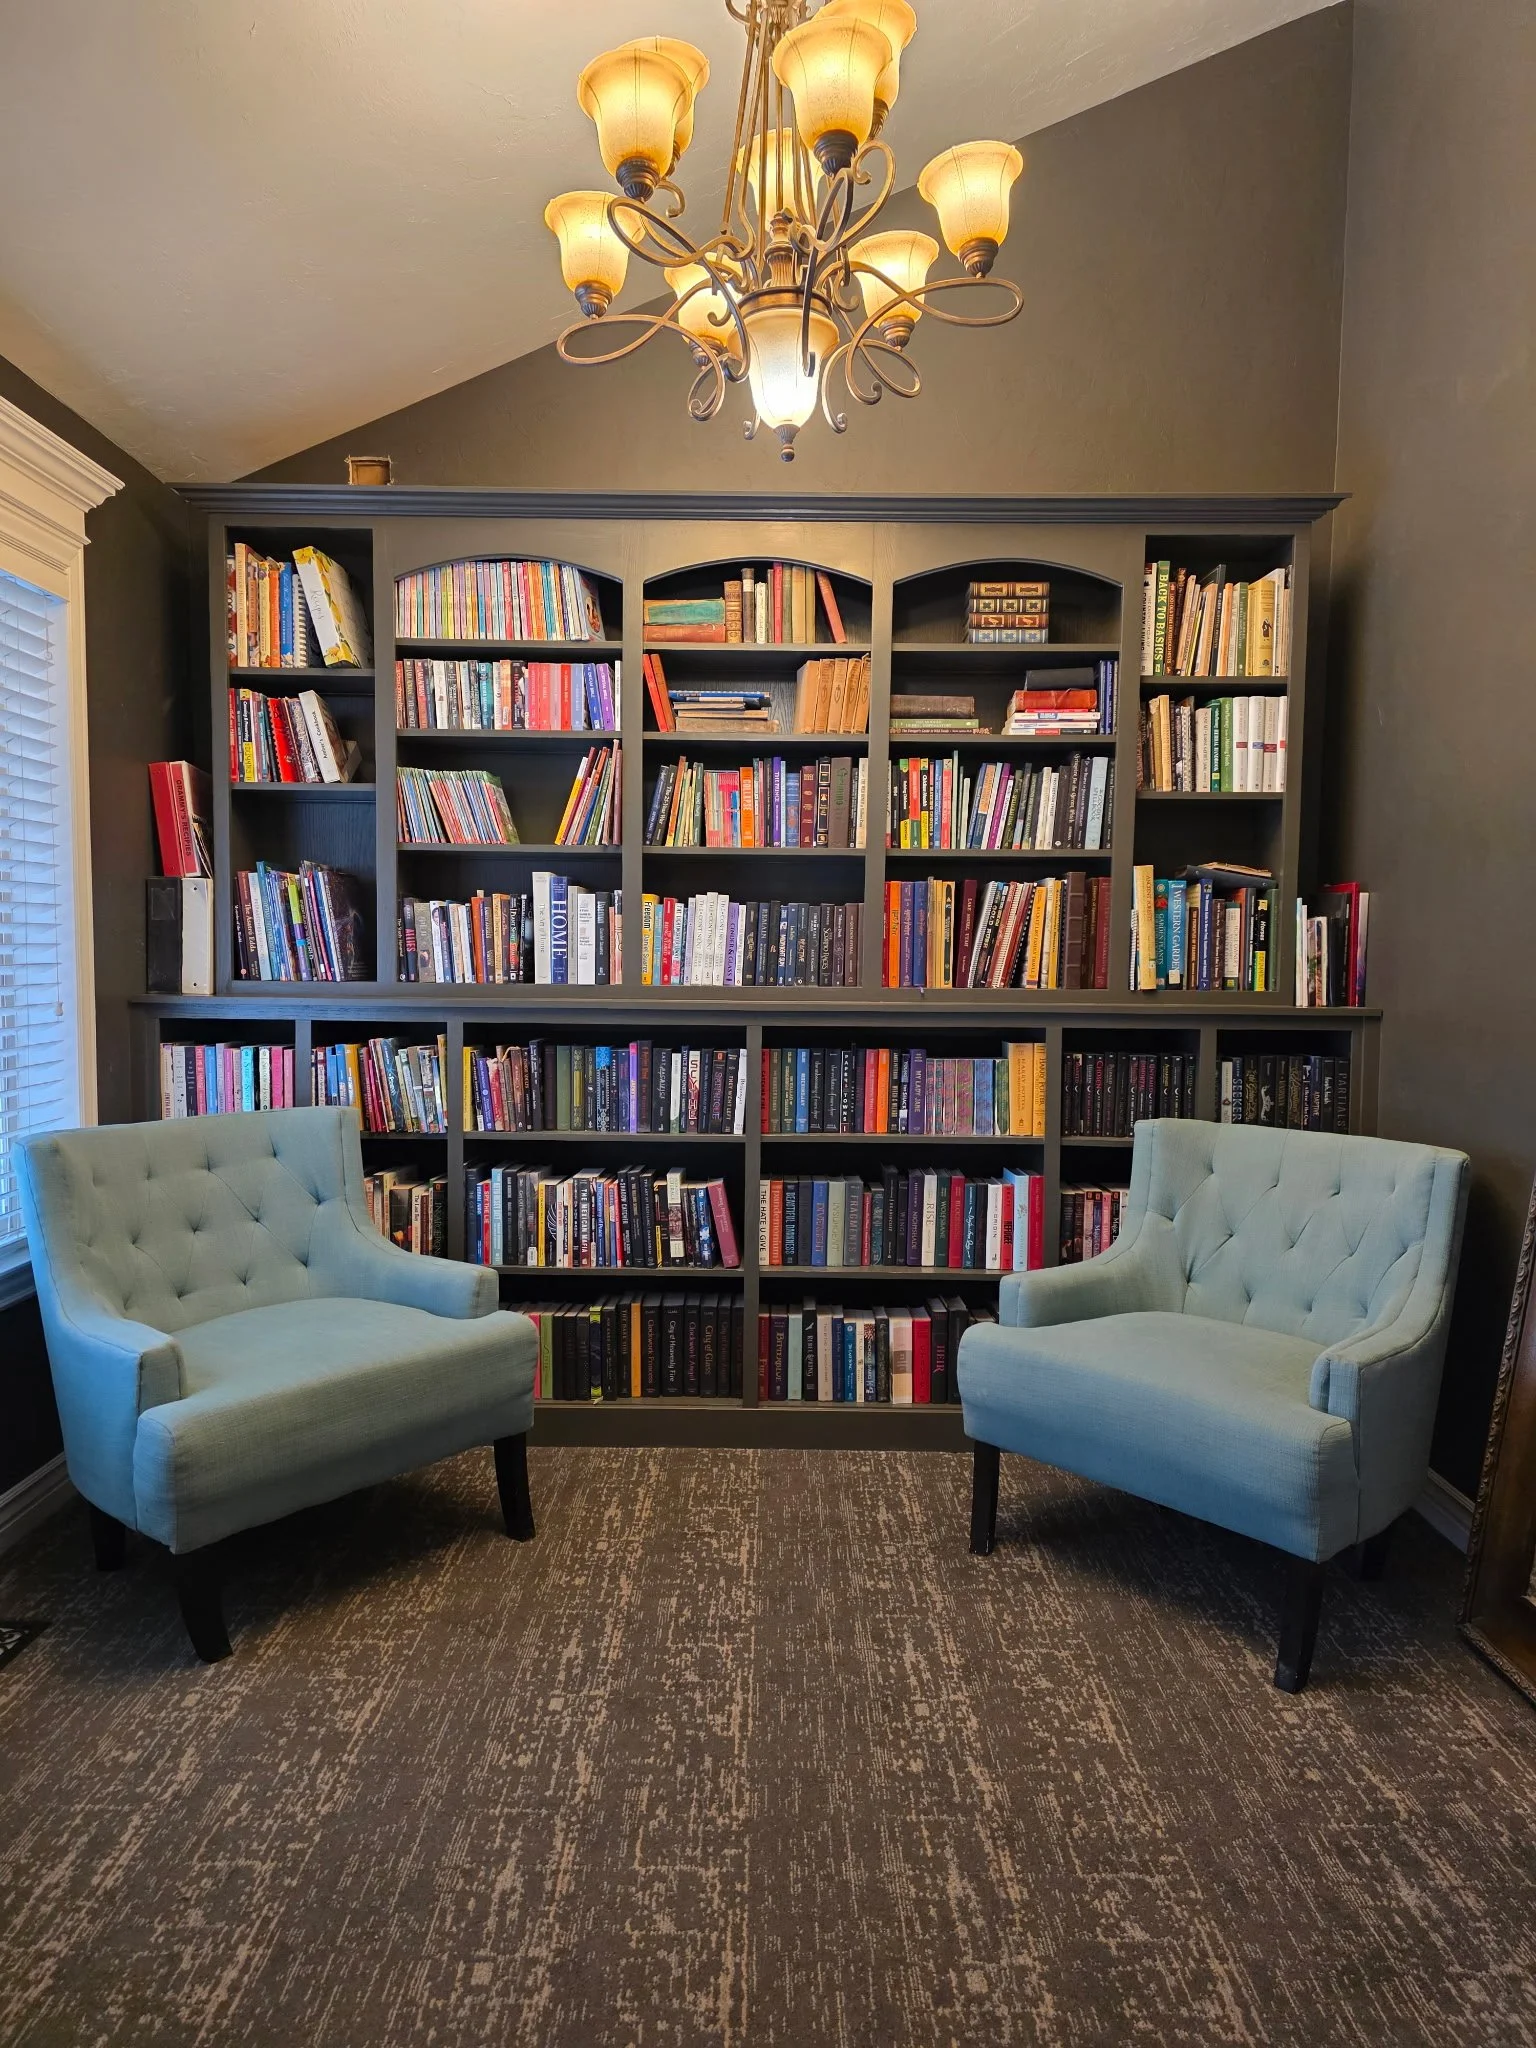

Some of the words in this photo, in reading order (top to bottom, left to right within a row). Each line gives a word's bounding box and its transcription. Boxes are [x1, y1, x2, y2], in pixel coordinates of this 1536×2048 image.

[1158, 574, 1168, 603] BACK
[1157, 606, 1166, 619] TO
[1154, 622, 1165, 660] BASICS
[743, 779, 751, 811] COLLAPSE
[176, 780, 186, 819] GRAMMY'S
[182, 822, 191, 856] RECIPIES
[644, 902, 652, 929] Freedom
[989, 905, 997, 926] GOLD
[1172, 890, 1182, 933] WESTERN
[405, 928, 415, 952] ALLIES
[552, 900, 567, 960] HOME
[822, 928, 831, 952] SCORPIO
[983, 929, 991, 948] RUSH
[642, 954, 650, 973] Suarez
[1171, 935, 1180, 972] GARDEN
[1233, 1078, 1242, 1121] SEEKER
[1337, 1073, 1347, 1126] PARTIALS
[786, 1192, 795, 1222] BEAUTIFUL
[926, 1203, 934, 1225] RISE
[772, 1191, 781, 1257] pandemonium
[816, 1202, 824, 1252] DIVERGENT
[832, 1202, 840, 1251] INSURGENT
[849, 1196, 858, 1252] FRAGMENTS
[1004, 1221, 1012, 1245] REFUGEE
[785, 1225, 795, 1255] DARKNESS
[668, 1321, 676, 1333] City
[688, 1322, 696, 1358] Clockwork
[703, 1326, 713, 1343] City
[668, 1341, 676, 1368] Heavenly
[704, 1353, 713, 1375] Glass
[775, 1332, 784, 1382] BITTERBLUE
[806, 1354, 814, 1376] SPRING
[933, 1344, 945, 1373] HEIR
